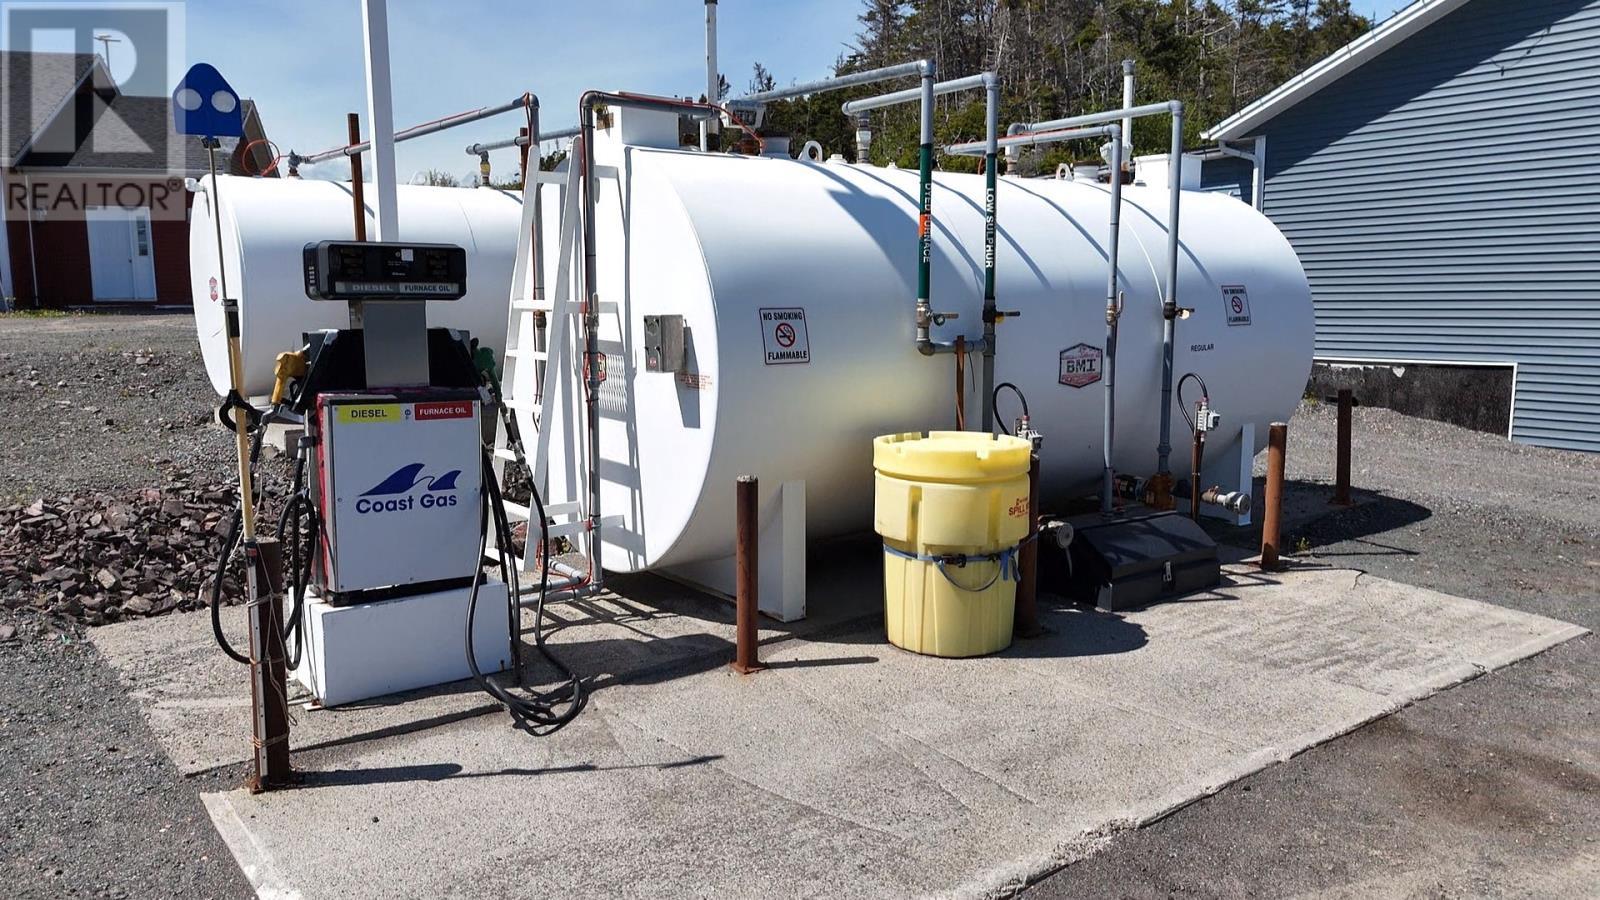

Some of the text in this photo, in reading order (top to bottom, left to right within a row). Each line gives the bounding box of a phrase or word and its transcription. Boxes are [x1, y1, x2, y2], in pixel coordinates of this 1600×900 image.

[923, 183, 932, 264] DYED FURNACE
[985, 187, 995, 268] LOW SULPHUR
[352, 283, 451, 293] DIESEL FURNACE OIL
[763, 311, 803, 321] NO SMOKING
[1190, 343, 1215, 352] REGULAR
[768, 350, 808, 361] FLAMMABLE
[1067, 358, 1097, 374] BMI
[351, 409, 388, 419] DIESEL
[419, 407, 453, 416] FURNACE
[356, 493, 458, 514] Coast Gas
